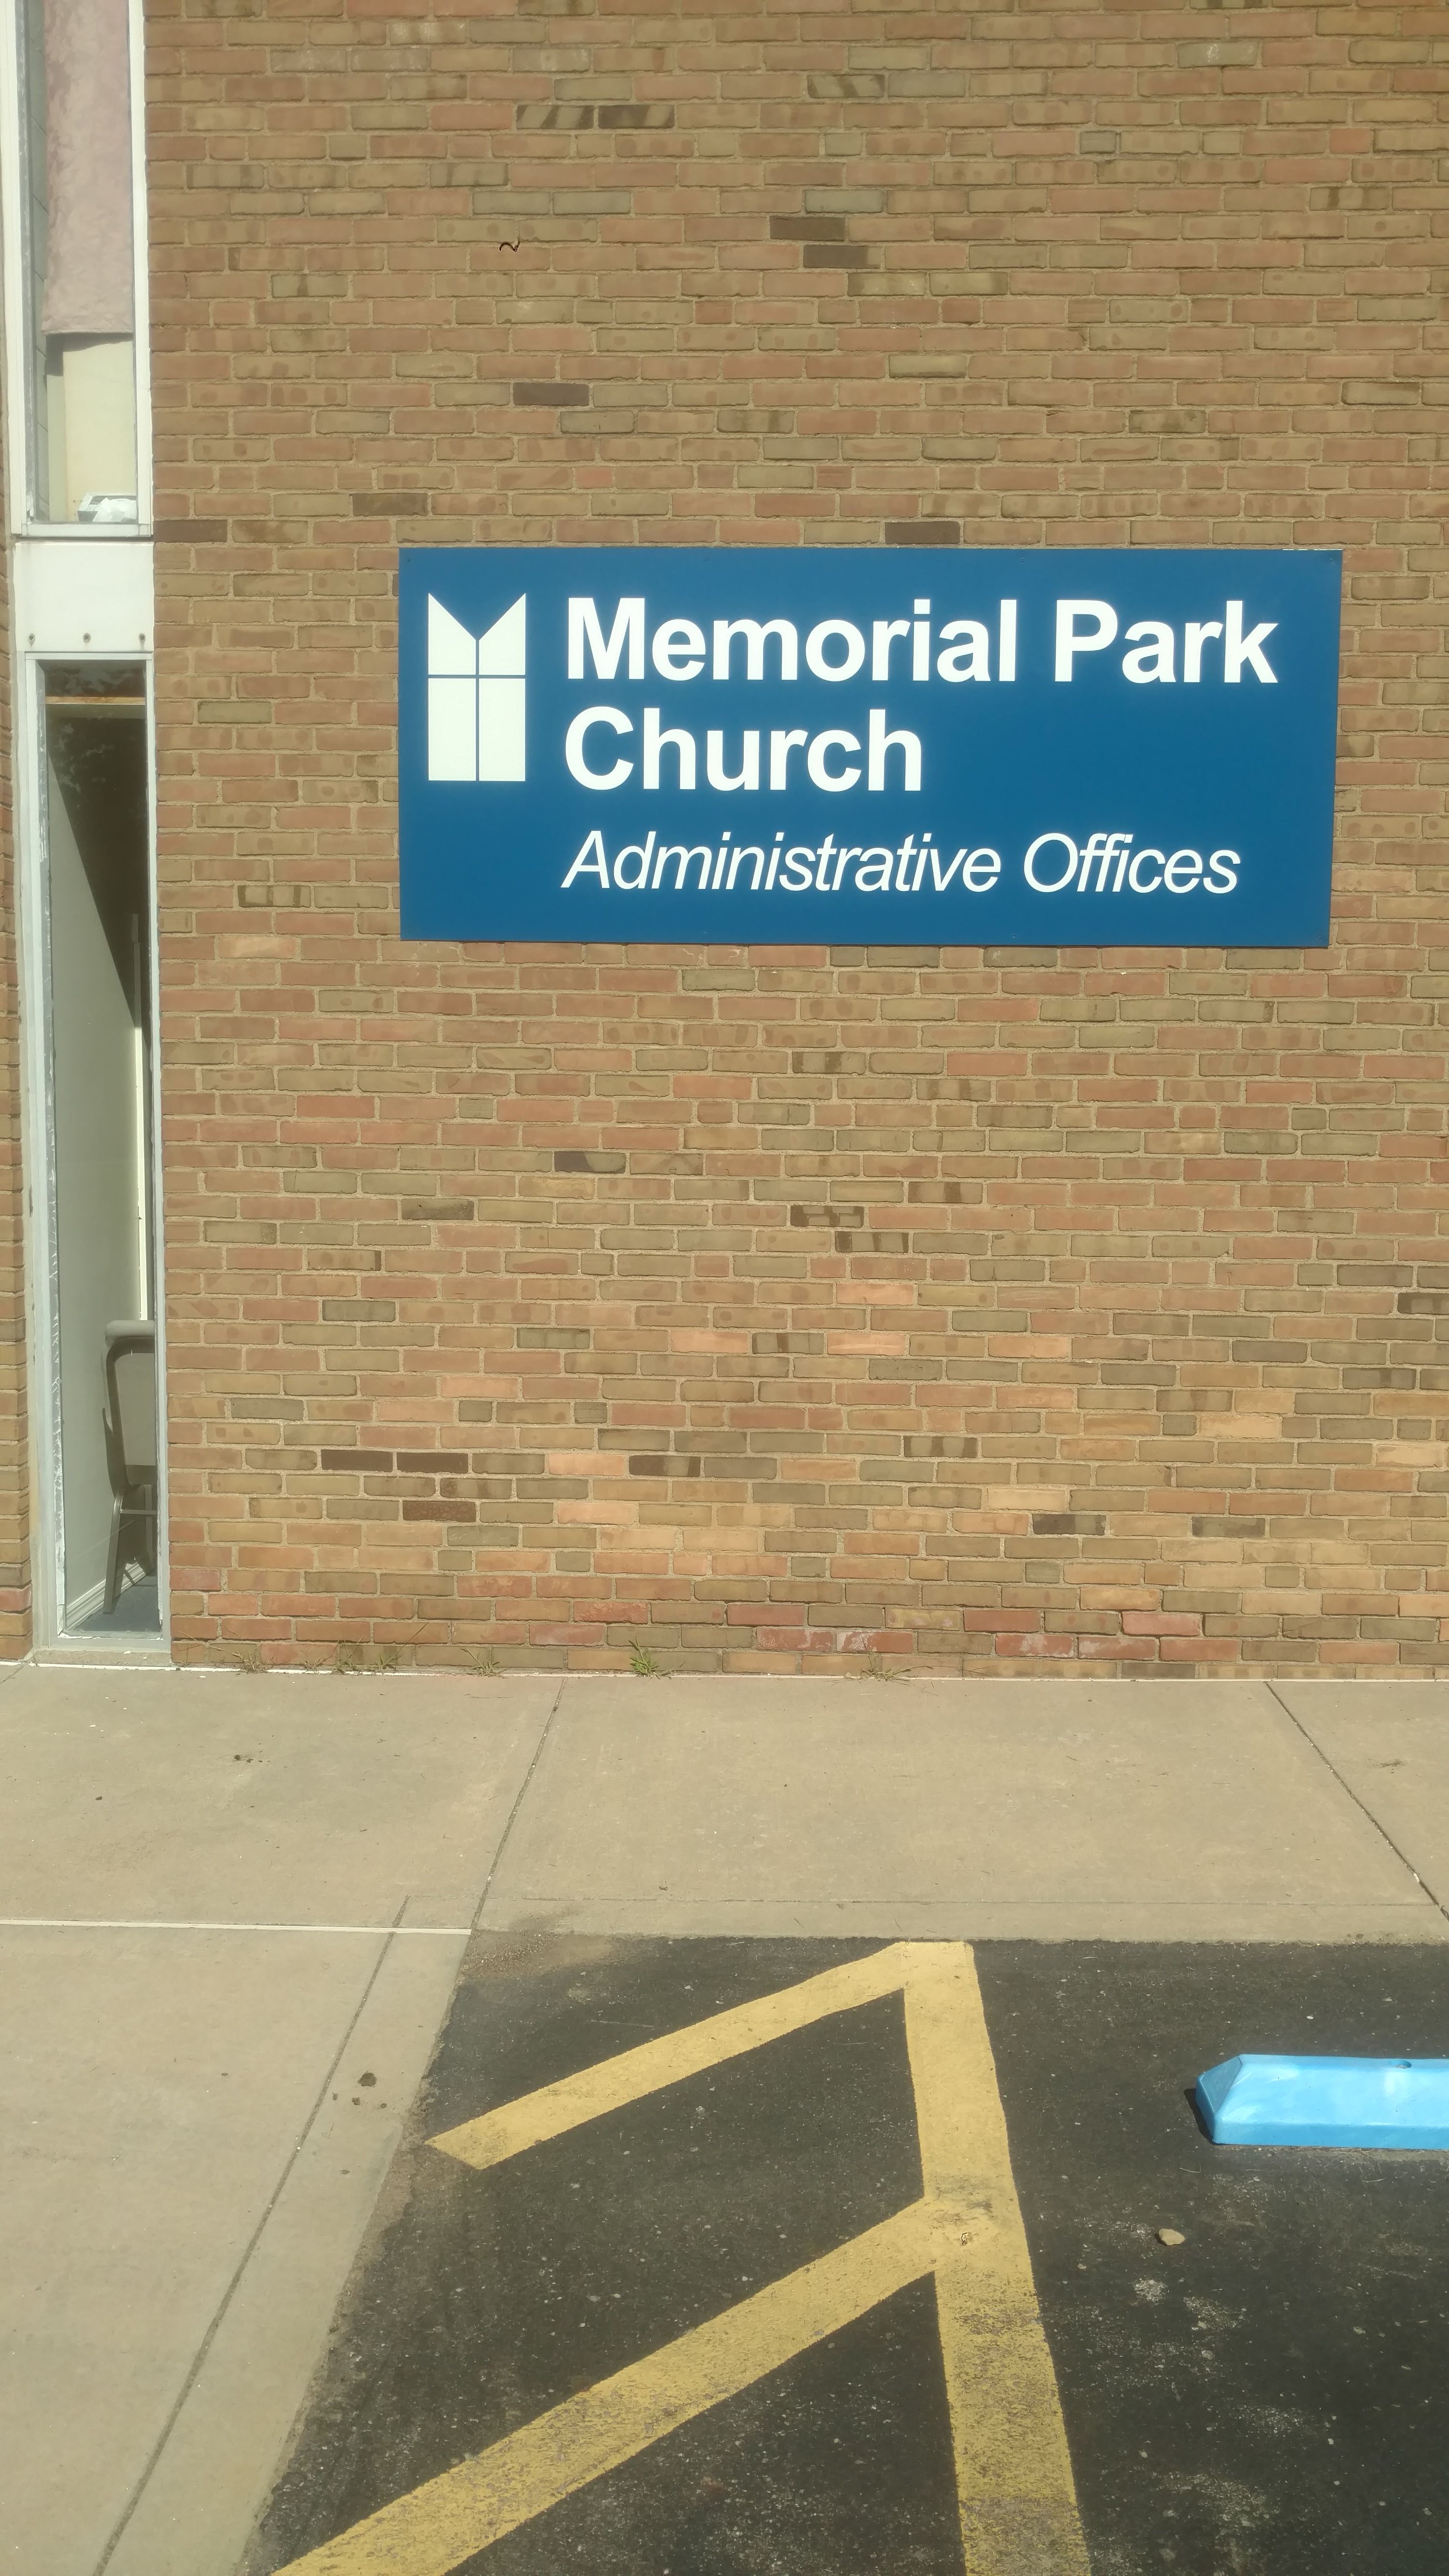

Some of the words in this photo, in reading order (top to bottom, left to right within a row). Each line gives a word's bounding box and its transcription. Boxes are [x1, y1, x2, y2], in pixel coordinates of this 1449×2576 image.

[567, 597, 1018, 683] Memorial
[1054, 599, 1279, 684] Park
[564, 705, 923, 792] Church
[560, 830, 1001, 892] Administrative
[1023, 832, 1241, 894] Offices
